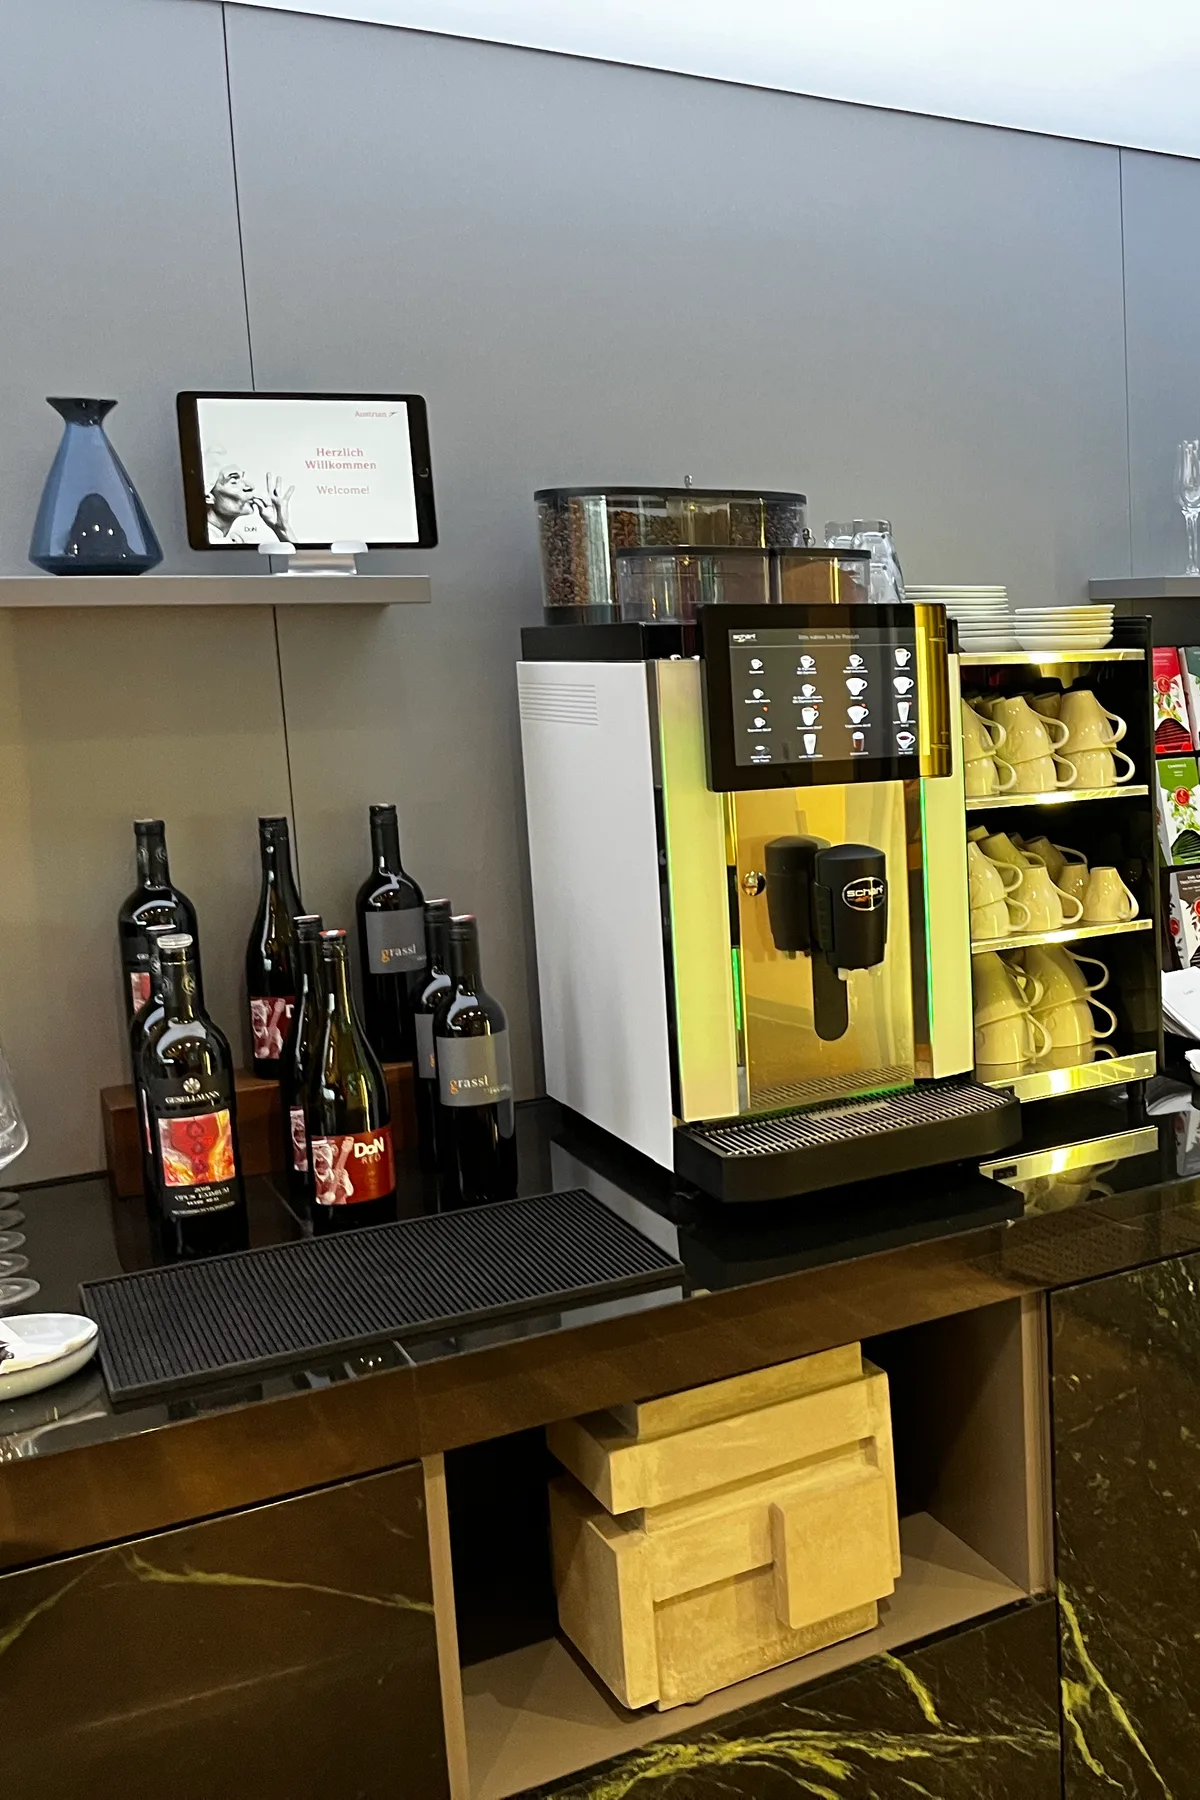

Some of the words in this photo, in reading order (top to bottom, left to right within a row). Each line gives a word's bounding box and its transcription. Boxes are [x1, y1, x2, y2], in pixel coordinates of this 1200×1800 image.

[316, 447, 364, 457] Herzlich
[305, 459, 377, 470] Willkommen
[316, 485, 370, 495] Welcome!
[380, 943, 417, 964] grassl
[449, 1074, 489, 1095] grassl
[354, 1136, 385, 1158] DoN
